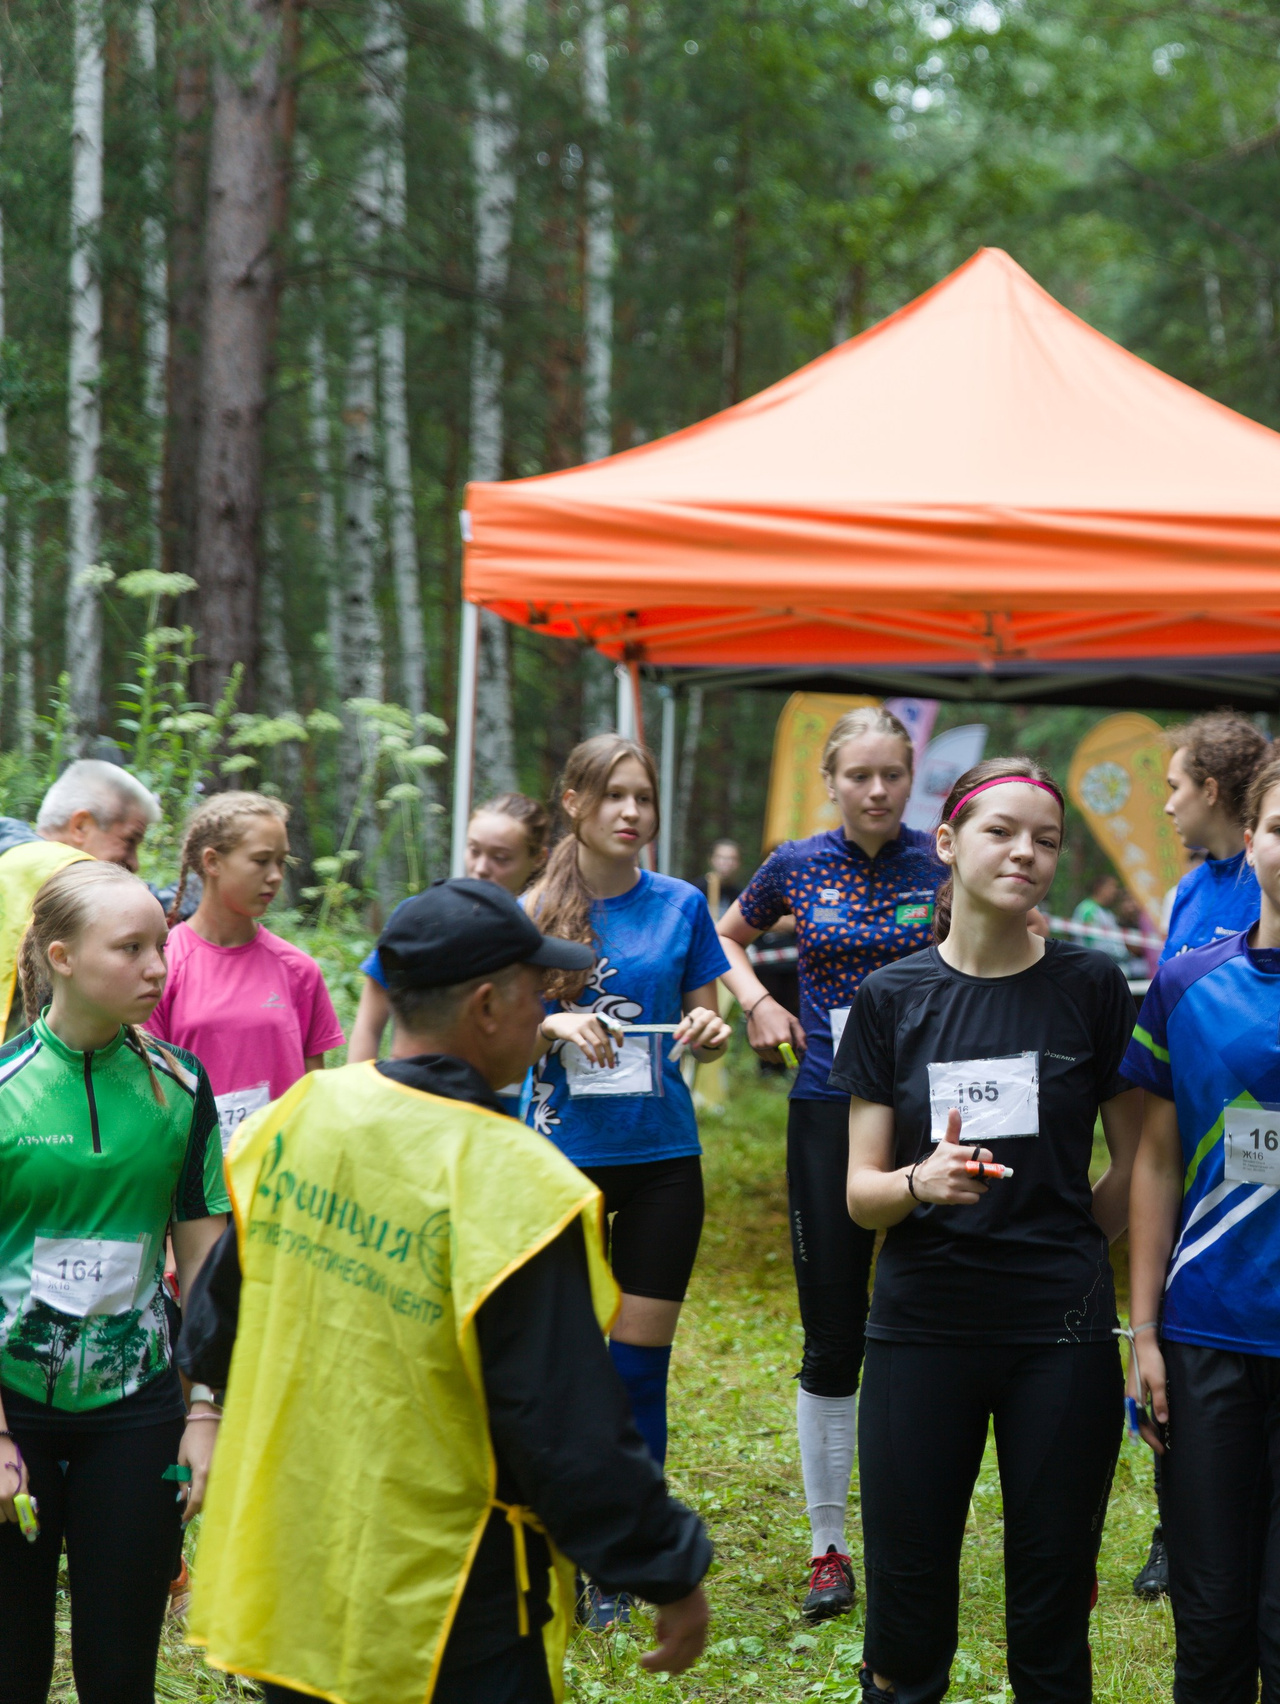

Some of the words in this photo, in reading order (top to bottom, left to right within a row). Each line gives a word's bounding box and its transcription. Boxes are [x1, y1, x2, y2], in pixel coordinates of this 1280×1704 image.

[1050, 1052, 1077, 1062] DEMIX
[954, 1080, 999, 1104] 165
[1242, 1150, 1264, 1160] Ж16
[57, 1258, 103, 1282] 164
